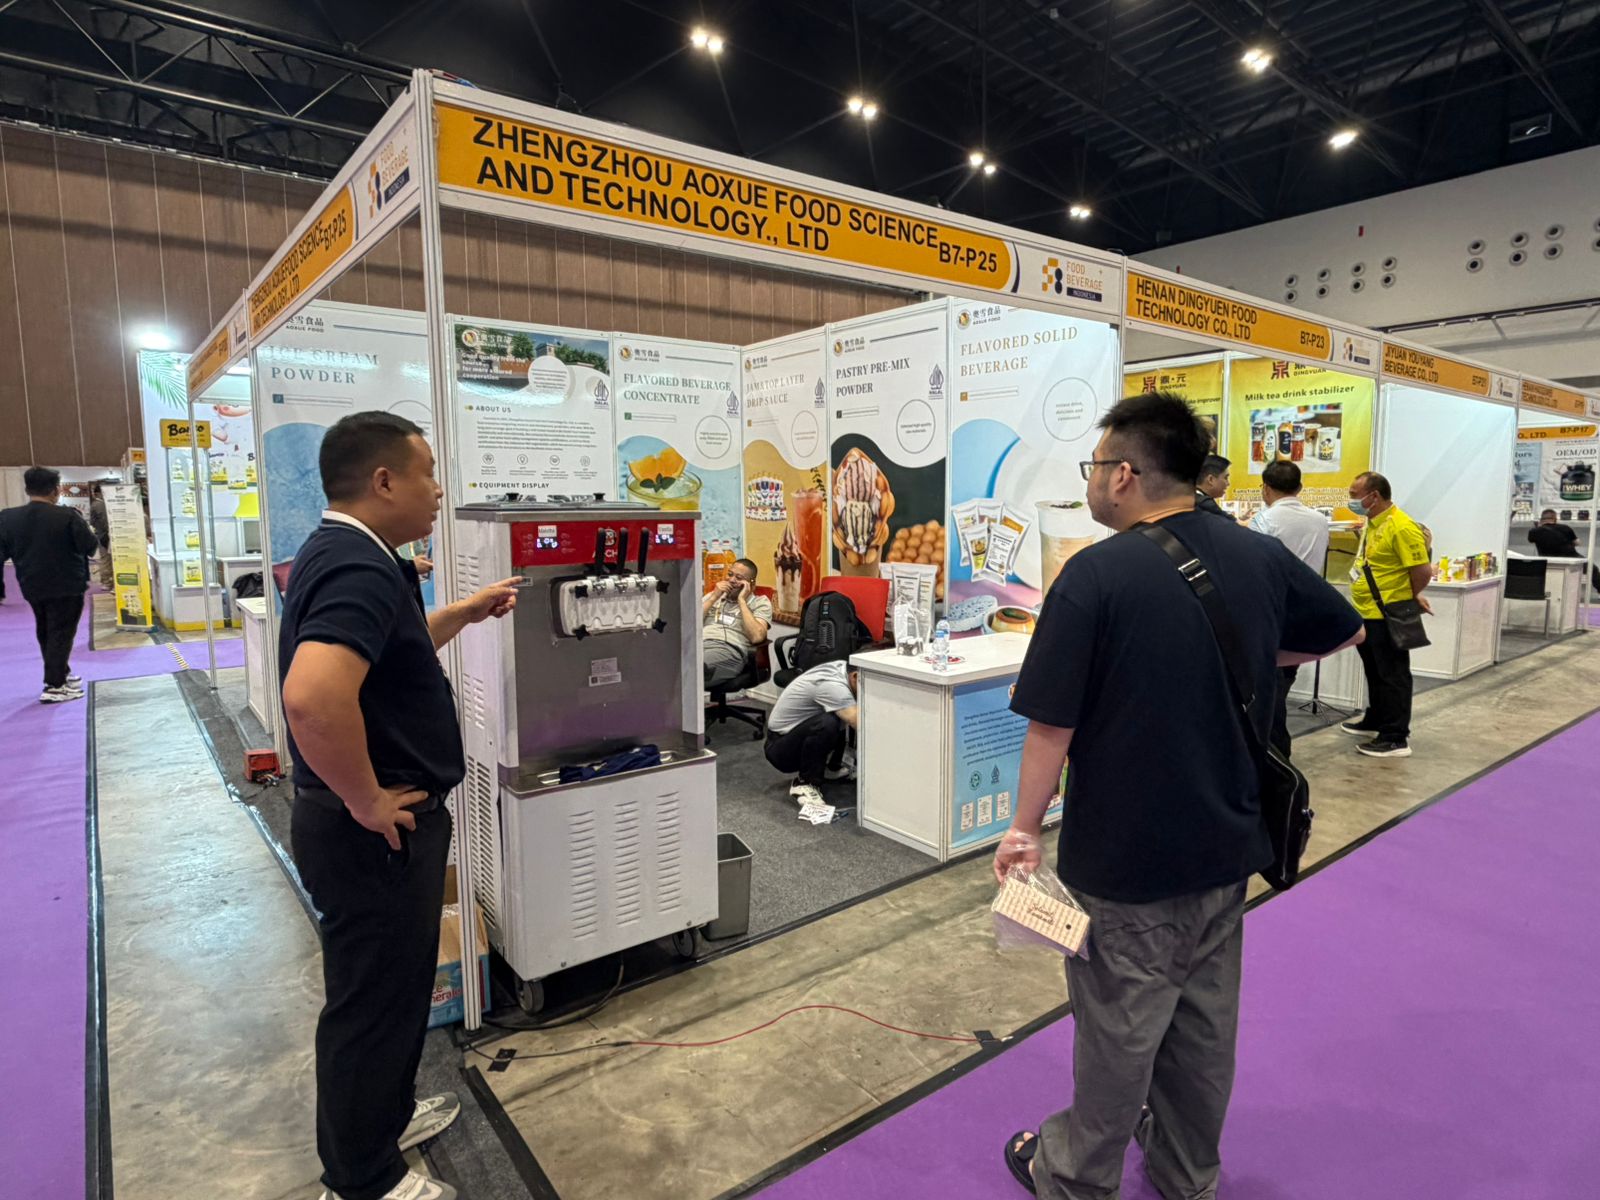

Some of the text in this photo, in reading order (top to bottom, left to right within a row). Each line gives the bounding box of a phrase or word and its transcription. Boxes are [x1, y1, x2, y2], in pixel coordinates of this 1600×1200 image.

[473, 116, 938, 248] ZHENGZHOU AOXUE FOOD SCIENCE
[477, 156, 554, 195] AND
[787, 221, 829, 251] LTD
[324, 208, 347, 251] B7-P25
[299, 221, 324, 264] SCIENCE
[939, 242, 997, 273] B7-P25
[1066, 261, 1086, 275] FOOD
[1066, 274, 1104, 291] BEVERAGE
[1072, 290, 1097, 300] INDONESIA
[1136, 278, 1258, 325] HENAN DINGYUEN FOOD
[1136, 298, 1210, 331] TECHNOLOGY
[1234, 323, 1251, 340] LTD
[961, 326, 1078, 356] FLAVORED SOLID
[1300, 331, 1325, 349] B7-P23
[312, 349, 379, 366] CREAM
[960, 356, 1029, 377] BEVERAGE
[270, 366, 356, 384] POWDER
[836, 357, 910, 380] PASTRY PRE-MIX
[1384, 360, 1417, 378] BEVERAGE
[1428, 371, 1439, 383] LTD
[623, 373, 732, 391] FLAVORED BEVERAGE
[836, 382, 873, 397] POWDER
[623, 390, 701, 405] CONCENTRATE
[746, 397, 764, 408] DRIP
[1245, 393, 1265, 402] Milk
[1282, 389, 1307, 398] drink
[1309, 386, 1355, 396] stabilizer
[476, 405, 500, 413] ABOUT
[1556, 449, 1597, 457] OEM/OD
